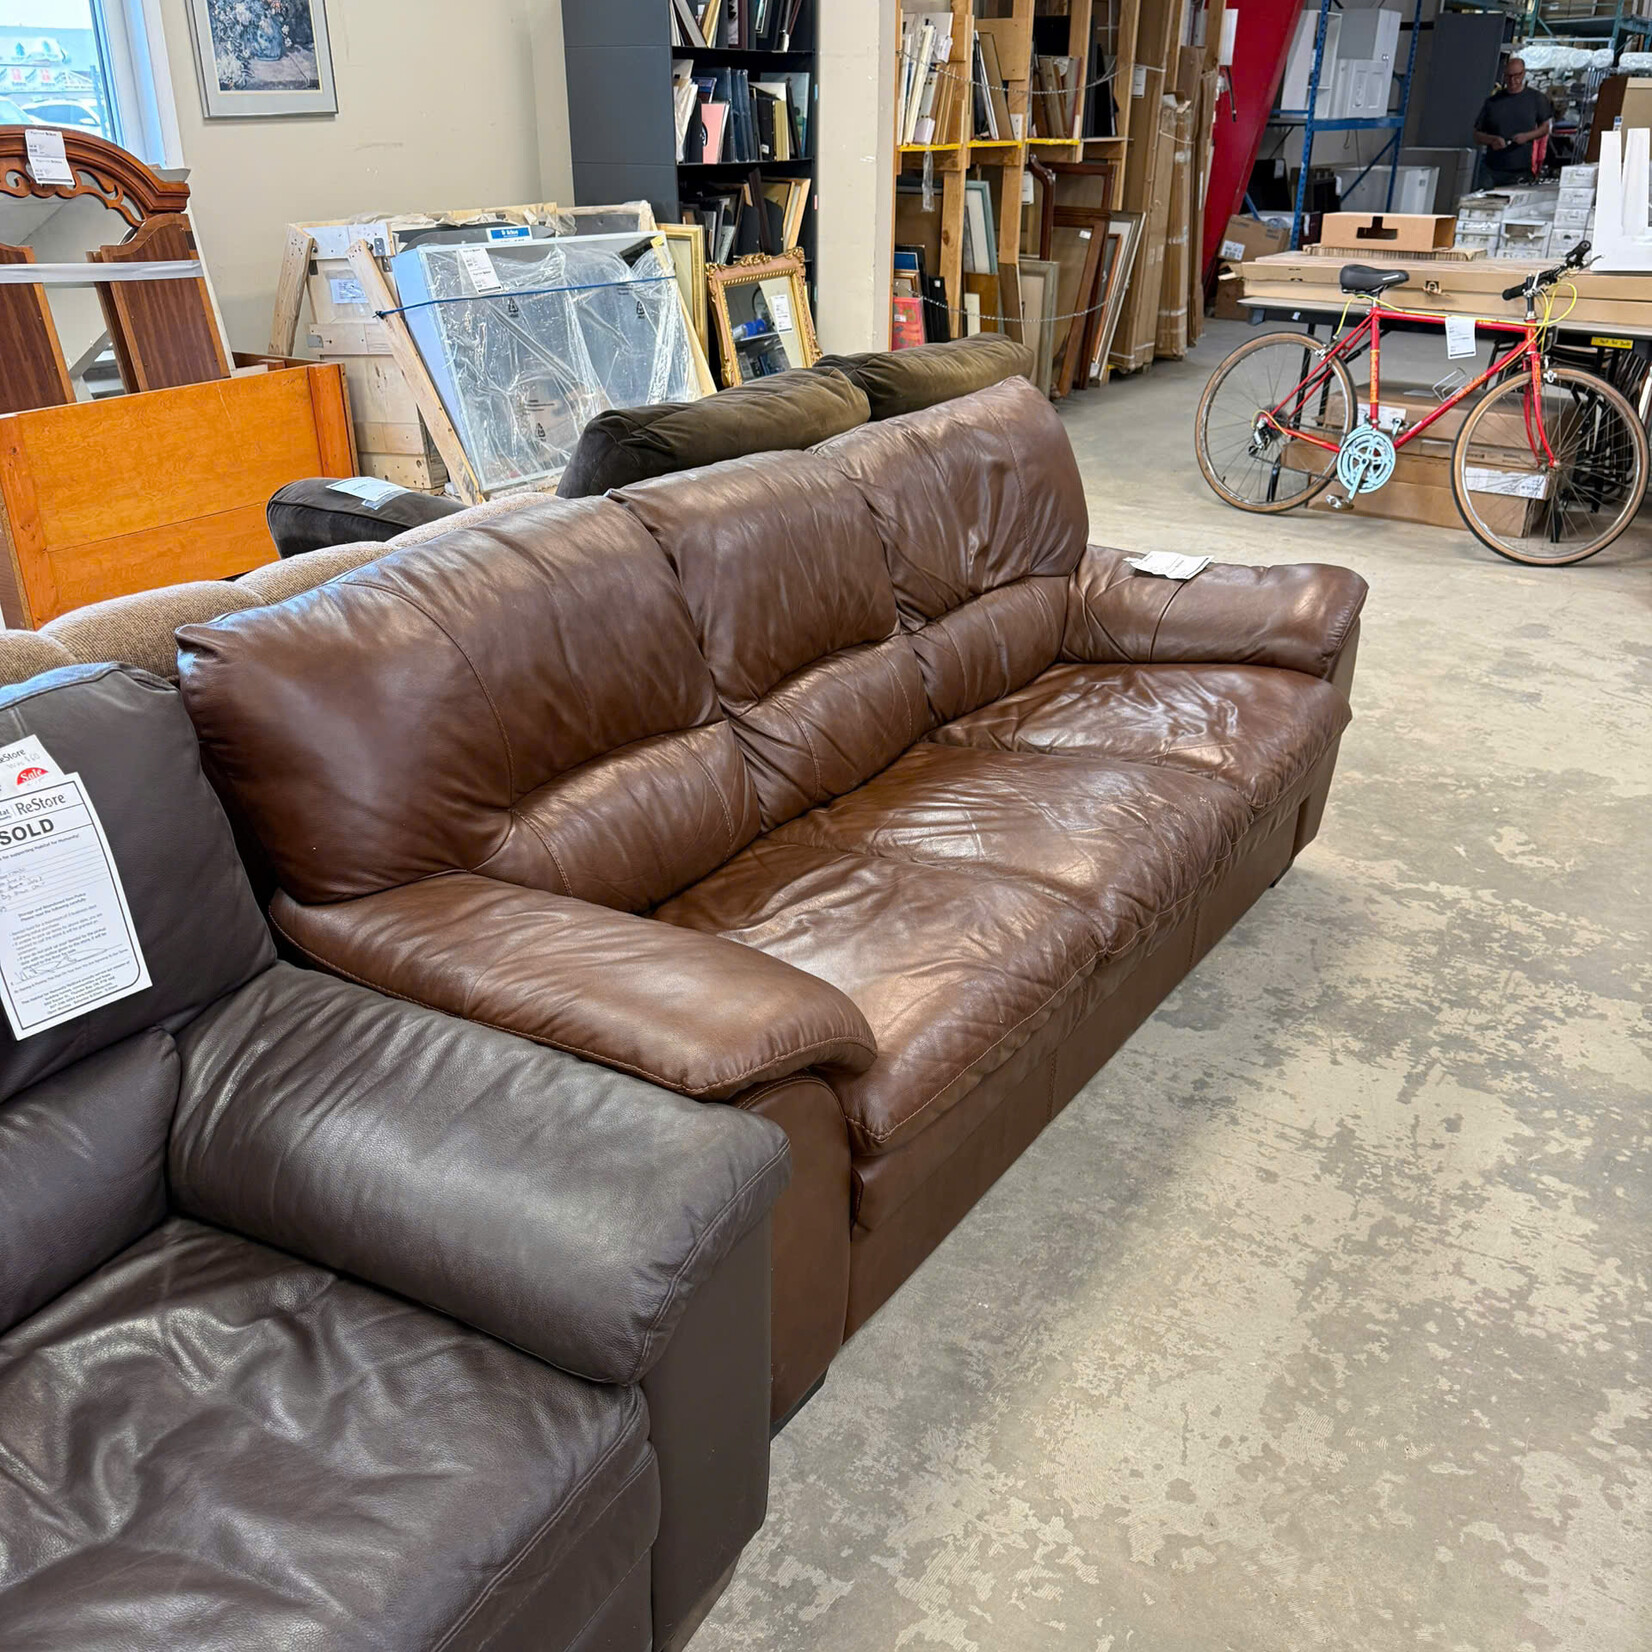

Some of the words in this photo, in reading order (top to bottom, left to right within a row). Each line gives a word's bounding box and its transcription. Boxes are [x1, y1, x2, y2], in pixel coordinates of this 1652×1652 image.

[0, 749, 26, 763] eStore
[20, 768, 42, 782] Sale
[15, 794, 66, 815] ReStore
[0, 818, 54, 845] SOLD
